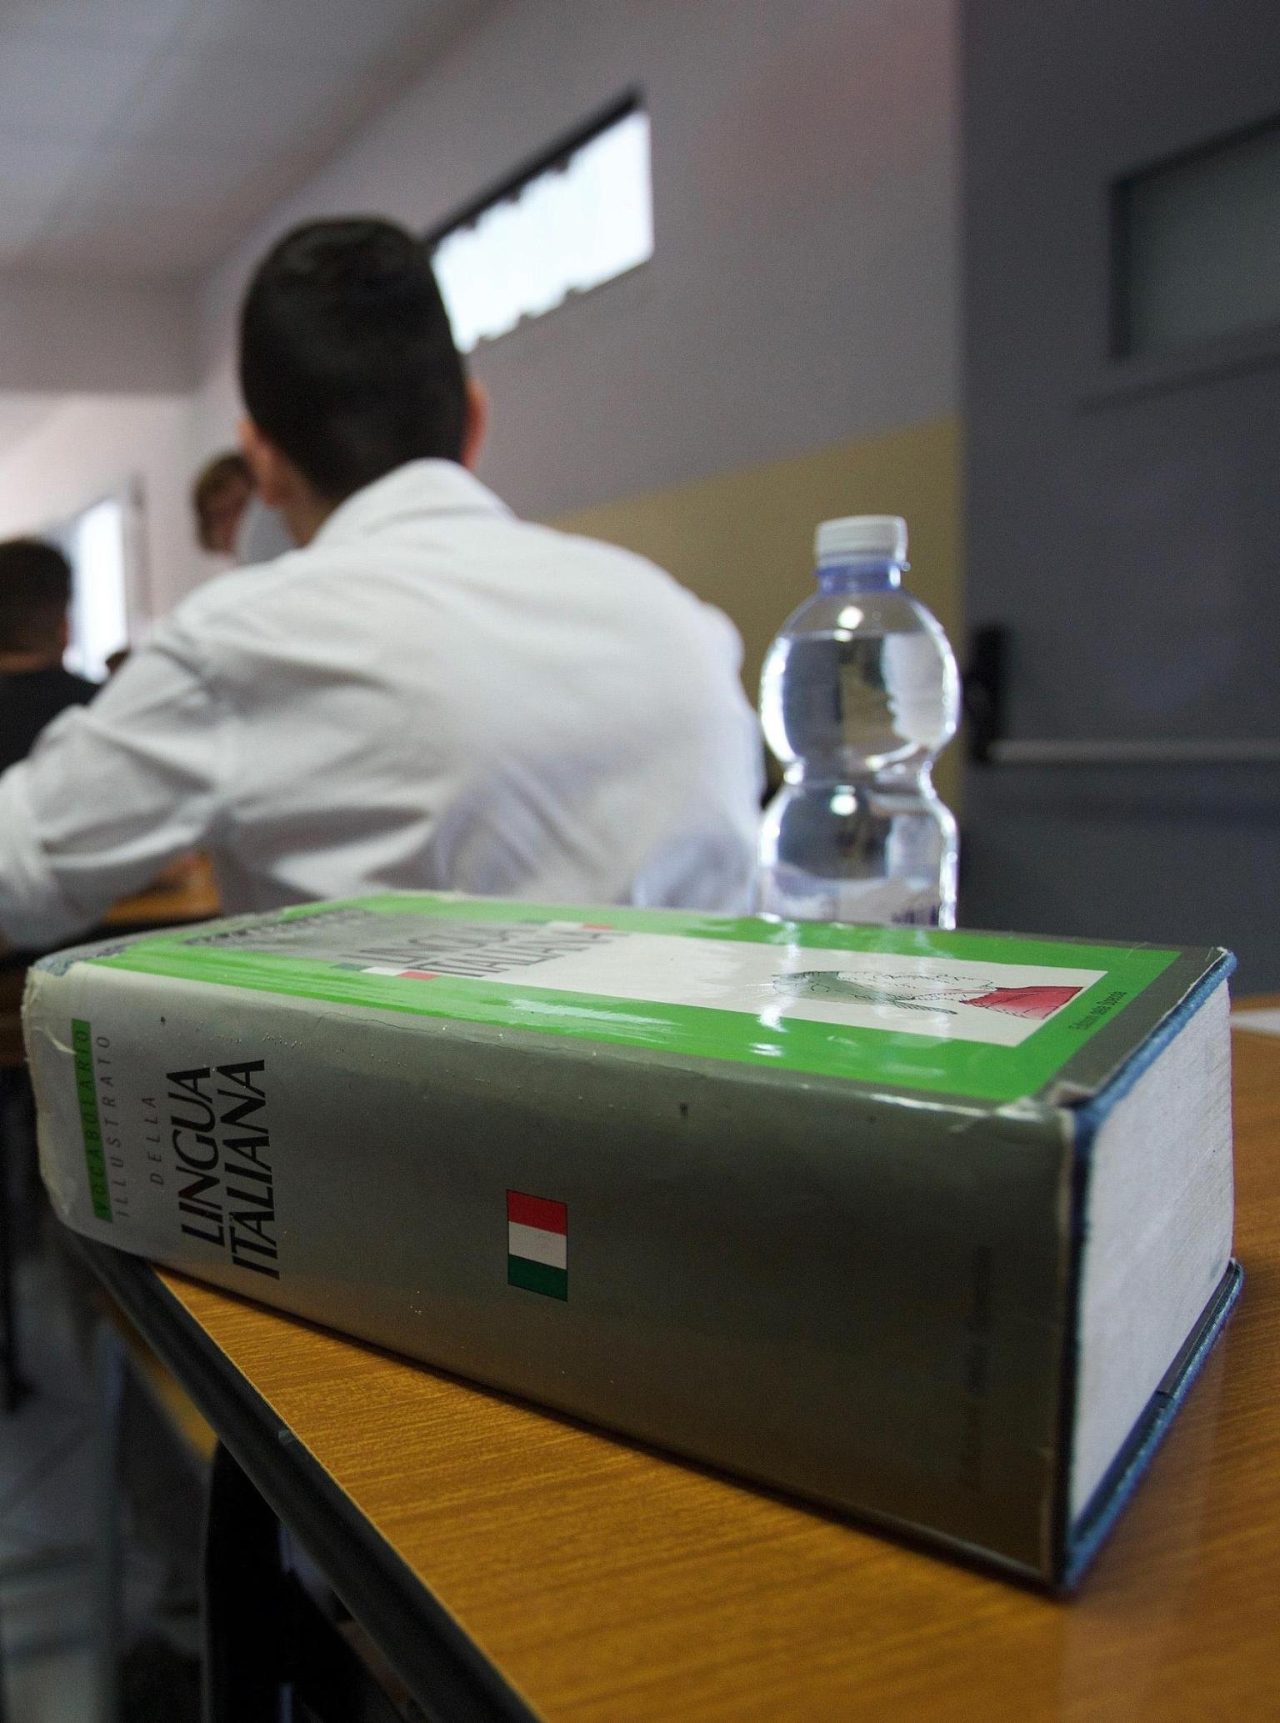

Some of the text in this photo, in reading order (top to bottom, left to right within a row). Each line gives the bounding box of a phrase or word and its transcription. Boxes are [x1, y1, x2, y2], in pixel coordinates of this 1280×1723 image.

[77, 1029, 111, 1215] VOCABOLARIO
[96, 1036, 129, 1217] ILLUSTRATO
[141, 1096, 164, 1186] DELLA
[166, 1067, 225, 1247] LINGUA
[217, 1059, 280, 1280] ITALIANA
